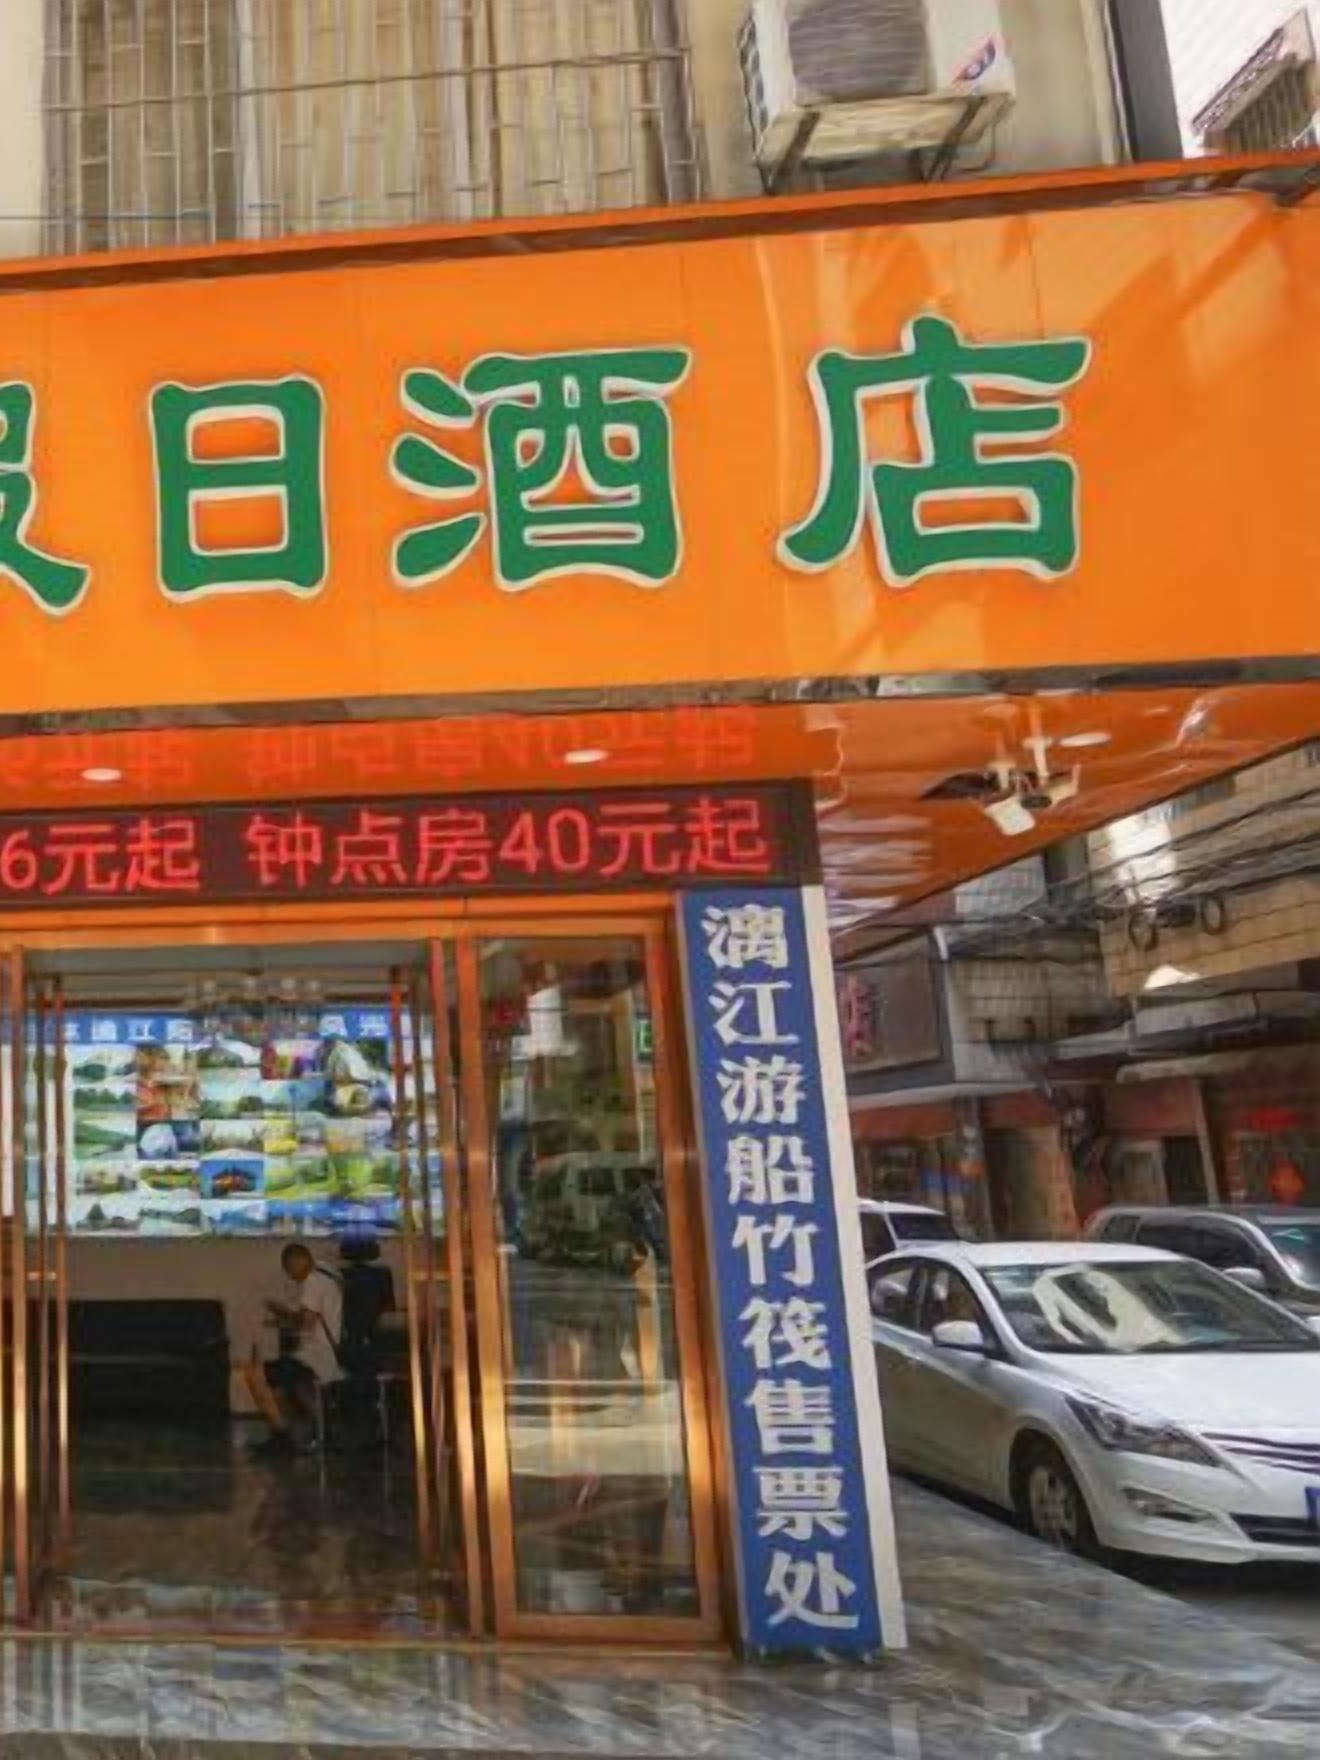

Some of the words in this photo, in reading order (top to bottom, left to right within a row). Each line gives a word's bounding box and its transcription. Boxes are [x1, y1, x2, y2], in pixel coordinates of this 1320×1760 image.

[245, 796, 771, 889] 钟点房40元起
[702, 904, 861, 1630] 漓江游船竹筏售票处
